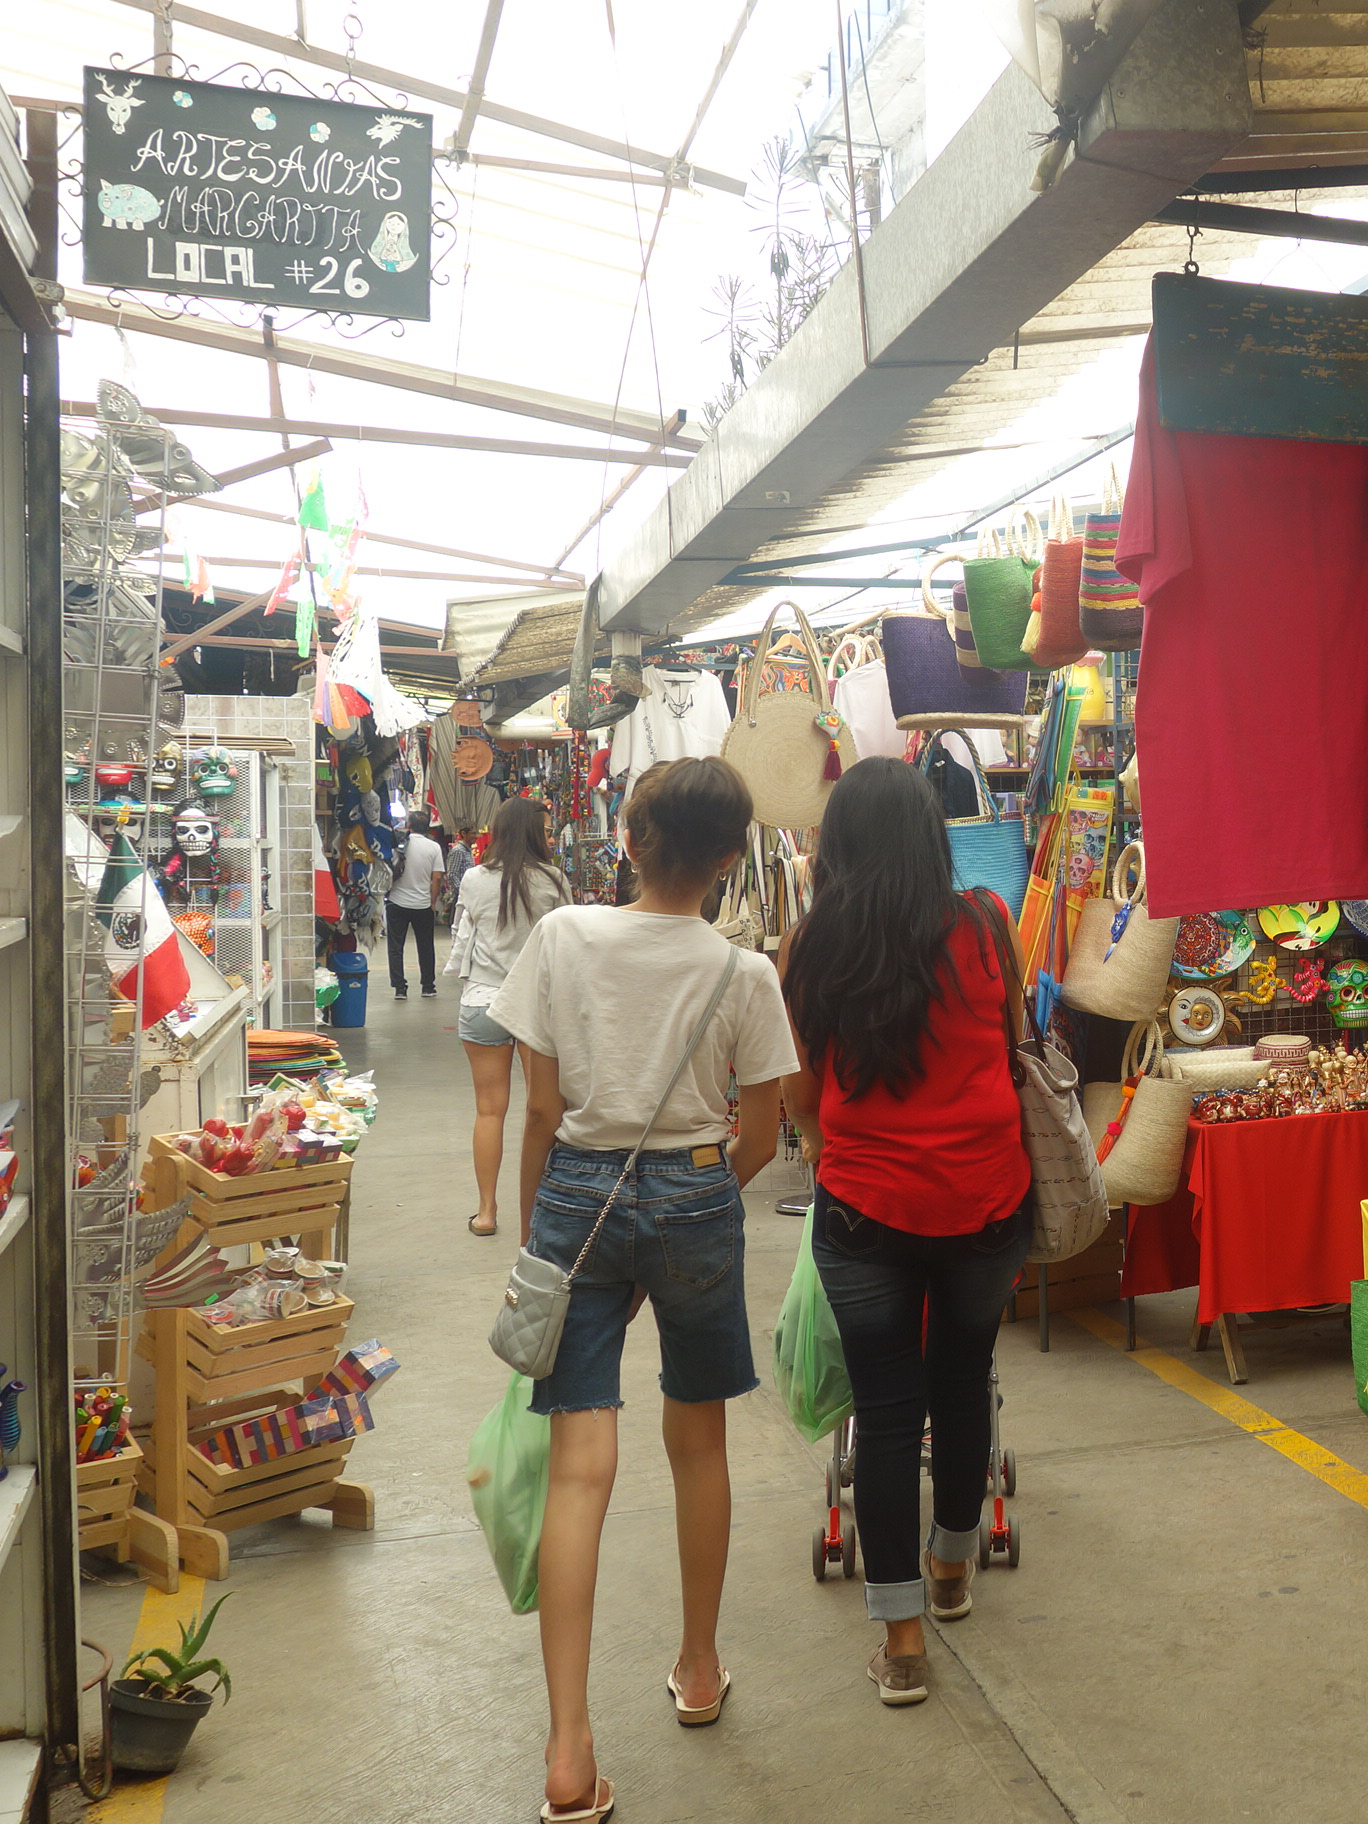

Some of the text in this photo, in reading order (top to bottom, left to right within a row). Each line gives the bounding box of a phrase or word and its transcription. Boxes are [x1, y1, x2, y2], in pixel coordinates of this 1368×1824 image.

[159, 186, 364, 254] MARGARITA
[147, 237, 370, 299] LOCAL #26
